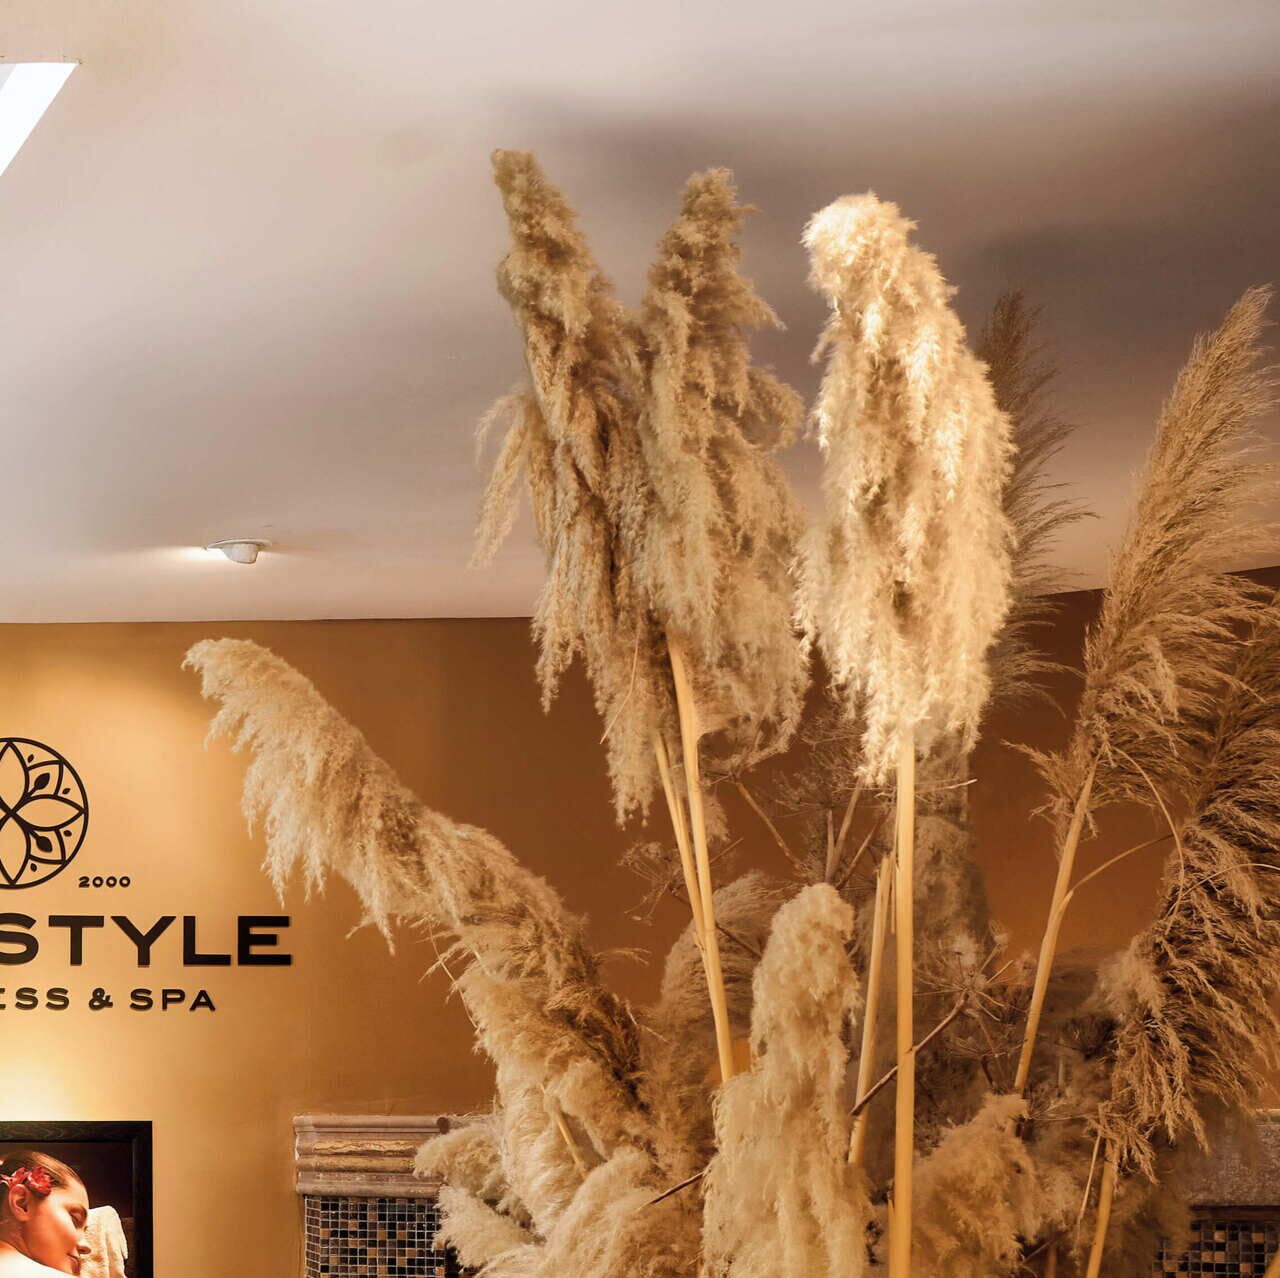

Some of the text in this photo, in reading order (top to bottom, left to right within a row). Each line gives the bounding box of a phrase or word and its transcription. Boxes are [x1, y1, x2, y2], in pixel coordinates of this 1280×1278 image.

[78, 876, 131, 888] 2000
[88, 987, 114, 1011] &
[129, 988, 216, 1012] SPA
